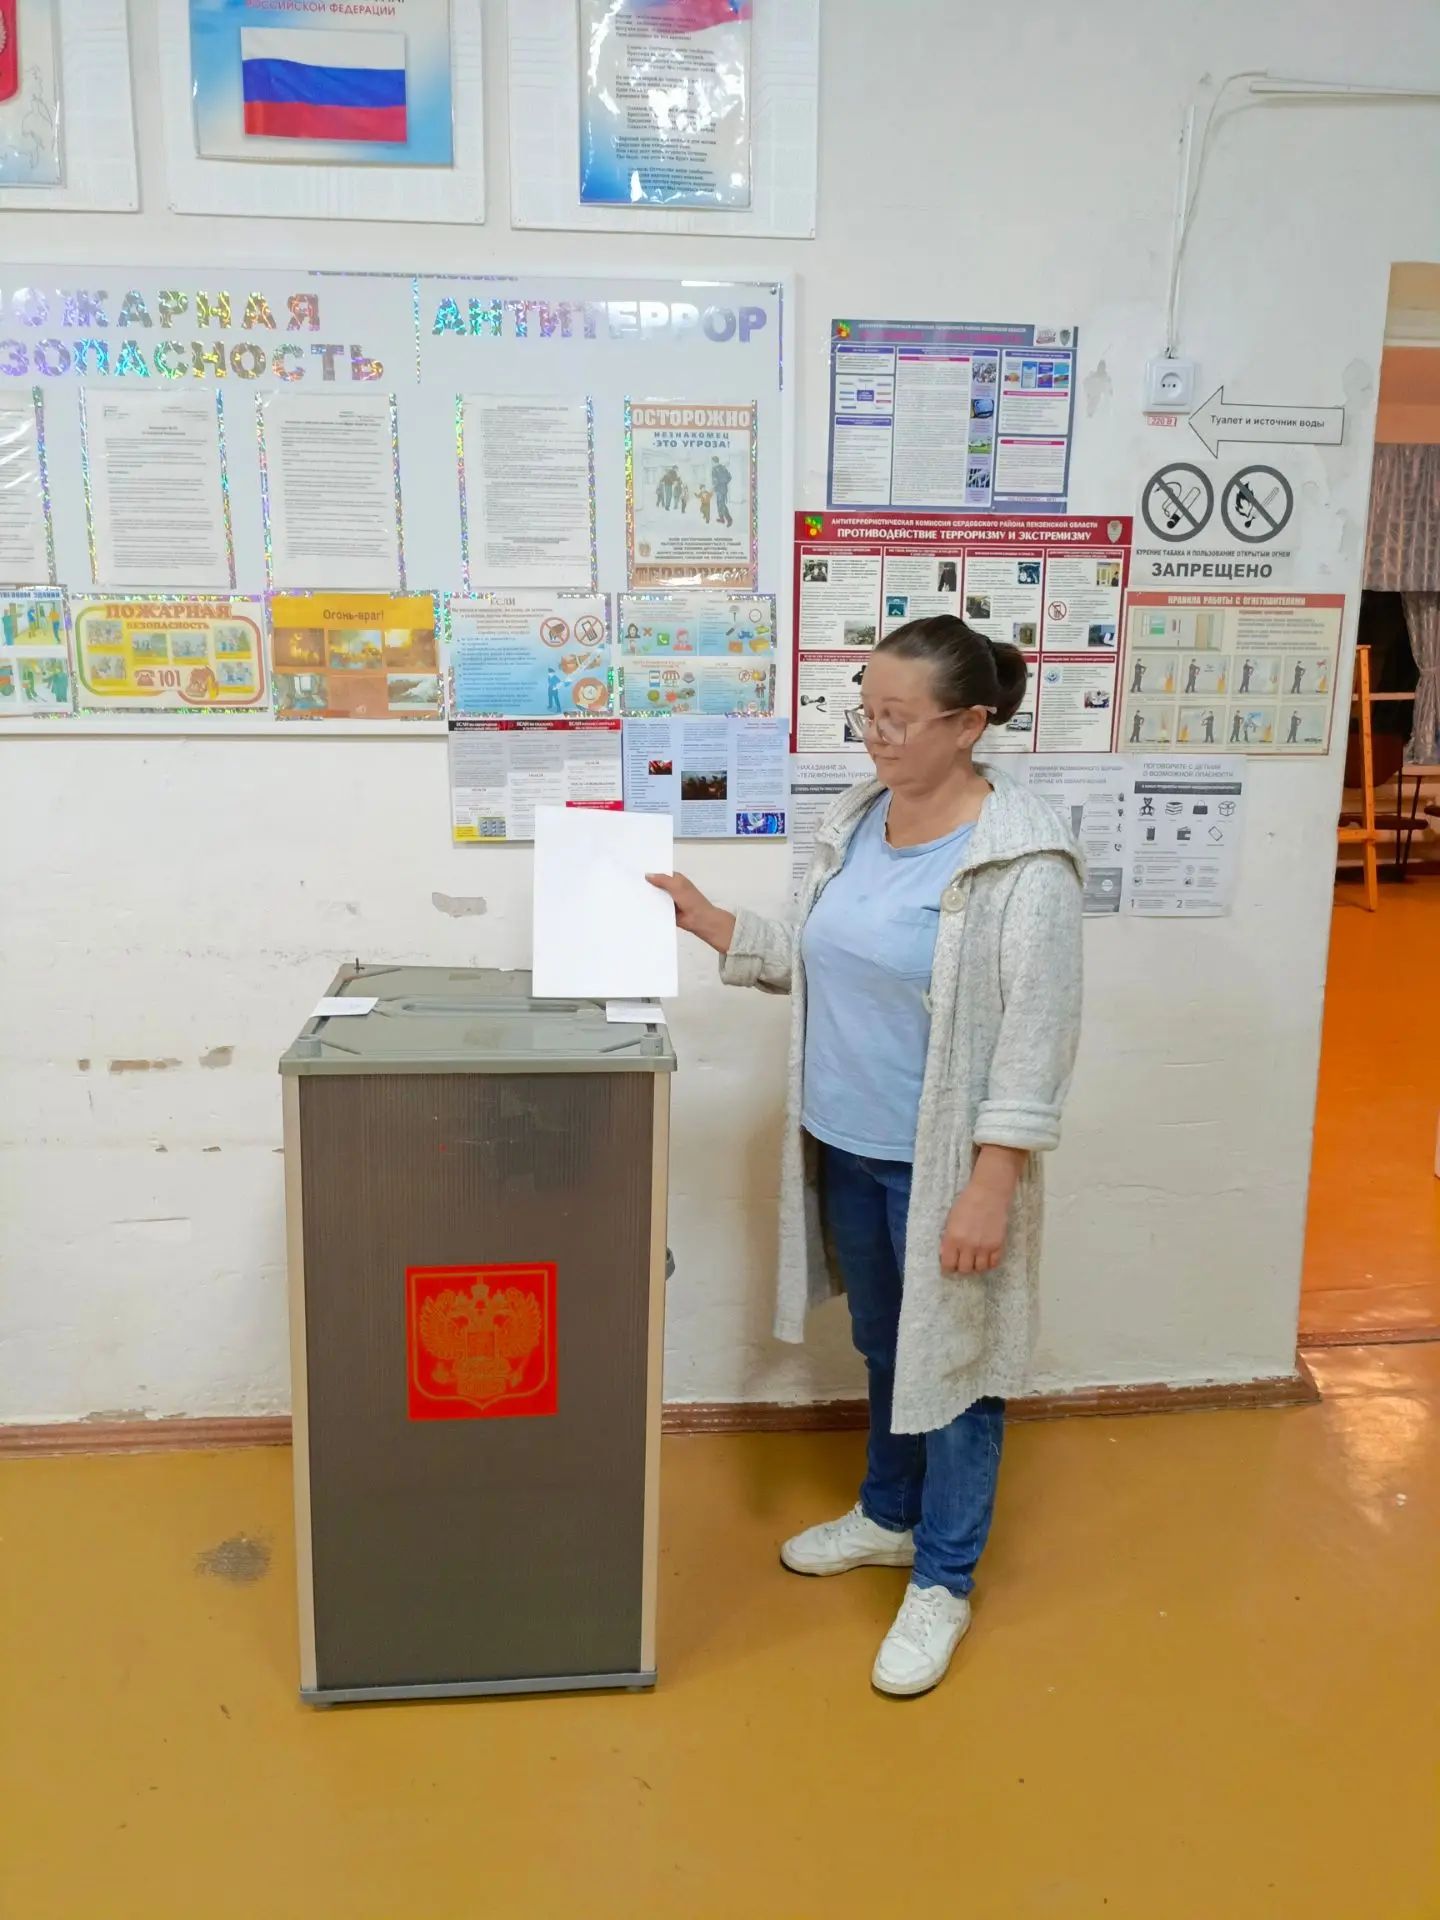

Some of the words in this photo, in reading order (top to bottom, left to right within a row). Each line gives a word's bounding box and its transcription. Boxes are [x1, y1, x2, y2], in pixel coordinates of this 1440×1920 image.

[329, 3, 396, 16] ФЕДЕРАЦИИ
[0, 287, 321, 332] ОЖАРНАЯ
[432, 297, 768, 343] АНТИТЕРРОР
[633, 408, 751, 427] ОСТОРОЖНО
[1211, 414, 1243, 426] Туалет
[1254, 418, 1297, 426] источник
[1299, 420, 1325, 428] воды
[654, 431, 729, 440] НЕЗНАКОМЕЦ
[682, 440, 730, 449] УГРОЗА!
[831, 518, 914, 527] АНТИТЕРРОРИСТИЧЕСКАЯ
[915, 519, 952, 527] КОМИССИЯ
[1000, 520, 1025, 528] РАЙОНА
[1026, 520, 1068, 529] ПЕНЗЕНСКОЙ
[837, 527, 937, 540] ПРОТИВОДЕЙСТВИЕ
[940, 529, 1007, 540] ТЕРРОРИЗМУ
[1008, 531, 1016, 540] И
[1018, 530, 1092, 541] ЭКСТРЕМИЗМУ
[1152, 562, 1273, 580] ЗАПРЕЩЕНО
[106, 603, 233, 619] ПОЖАРНАЯ
[323, 608, 384, 624] Огонь-враг!
[126, 621, 210, 630] БЕЗОПАСНОСТЬ
[157, 669, 182, 687] 101
[1176, 899, 1183, 909] 2
